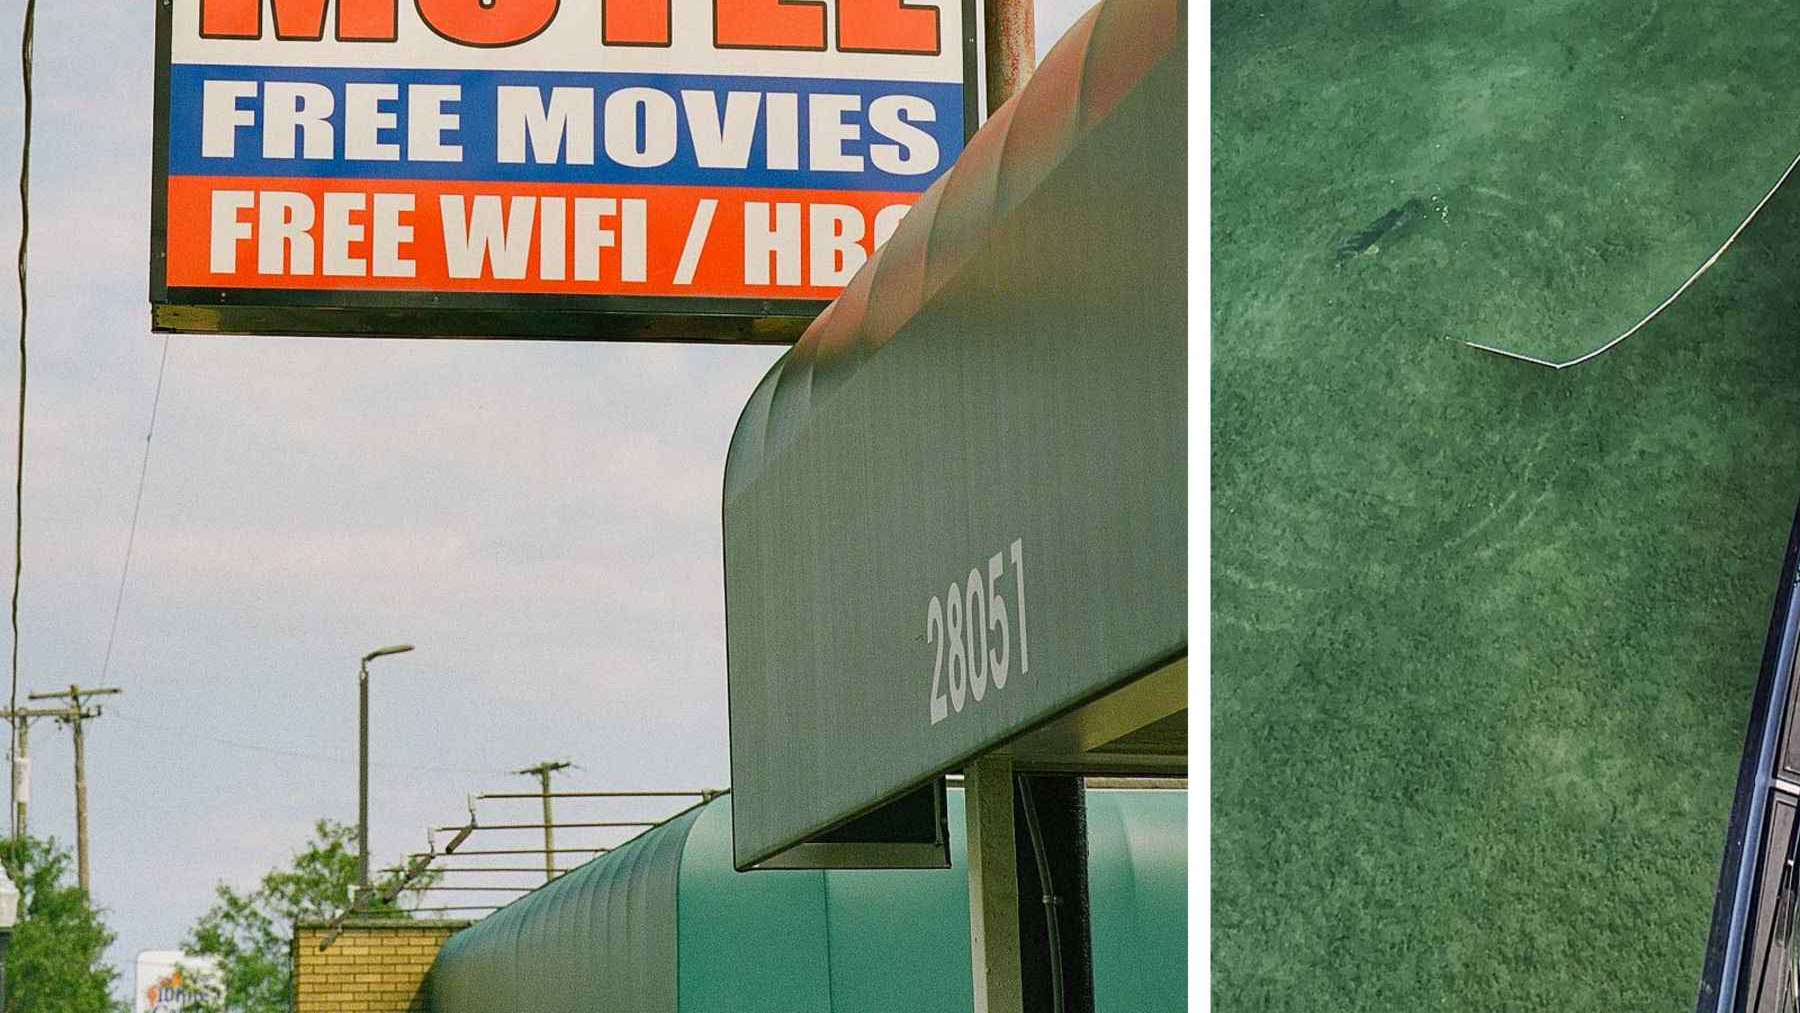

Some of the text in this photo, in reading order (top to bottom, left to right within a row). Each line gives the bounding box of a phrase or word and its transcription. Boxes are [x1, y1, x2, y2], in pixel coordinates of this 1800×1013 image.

[202, 80, 940, 176] FREE MOVIES
[209, 190, 417, 278] FREE
[440, 194, 648, 283] WIFI
[672, 199, 720, 286] /
[927, 538, 1029, 726] 28051
